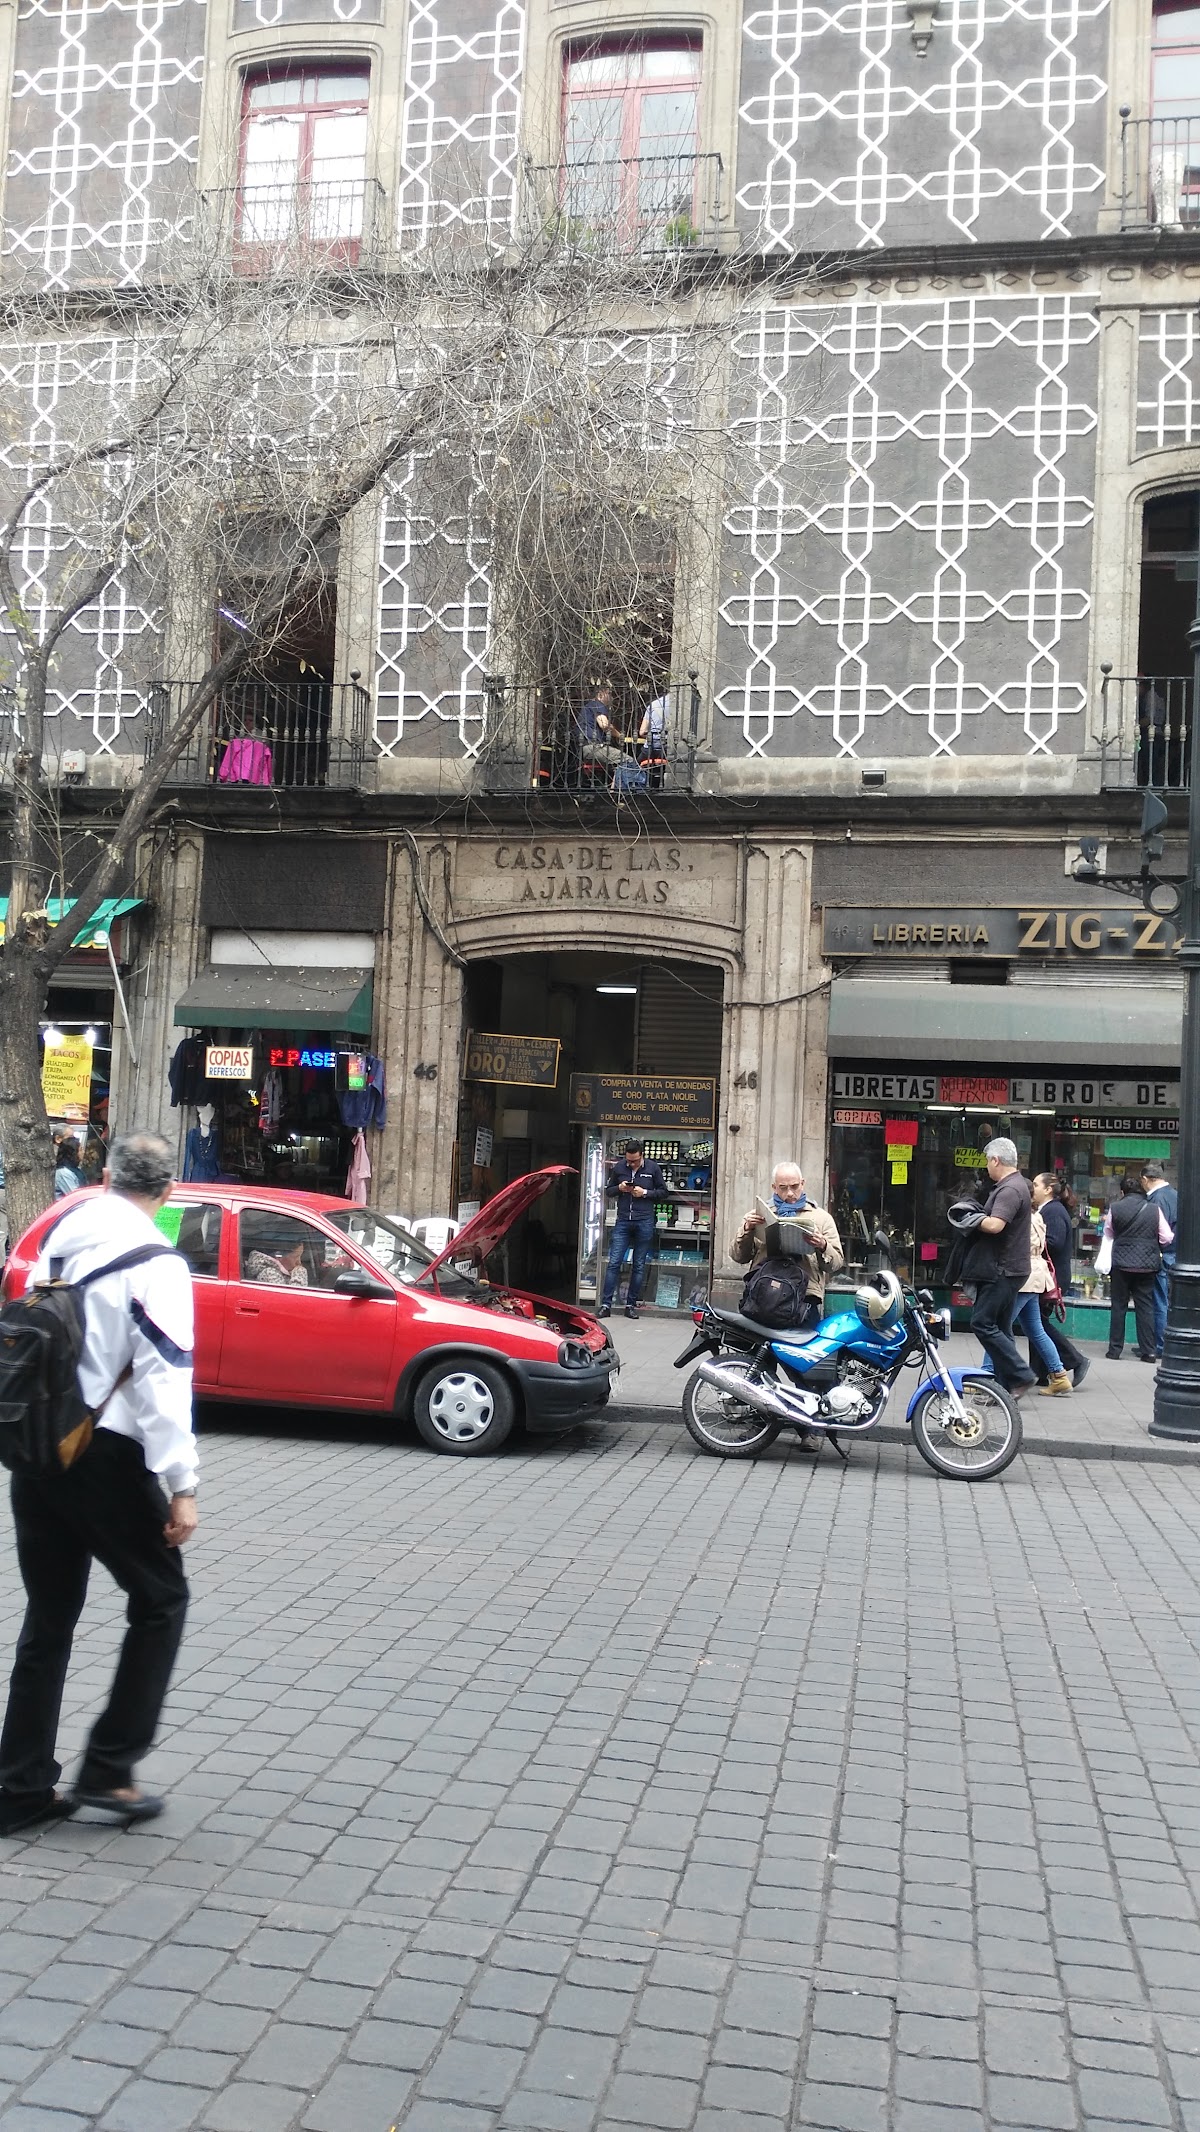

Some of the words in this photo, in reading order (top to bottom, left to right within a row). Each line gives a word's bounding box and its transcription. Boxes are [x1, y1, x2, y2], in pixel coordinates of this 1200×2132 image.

[520, 876, 670, 903] AJARACAS
[872, 923, 989, 944] LIBRERIA
[498, 1038, 525, 1048] JOYERIA
[531, 1040, 552, 1050] CESAR
[52, 1048, 80, 1059] TACOS
[209, 1050, 250, 1066] COPIAS
[511, 1055, 530, 1063] PLATA
[46, 1060, 74, 1068] SUADERO
[469, 1052, 506, 1073] ORO
[208, 1066, 246, 1077] REFRESCOS
[413, 1063, 438, 1081] 46
[601, 1078, 632, 1088] COMPRA
[632, 1080, 638, 1088] Y
[639, 1080, 663, 1089] VENTA
[665, 1081, 675, 1089] DE
[676, 1081, 711, 1091] MONEDAS
[734, 1070, 758, 1090] 46
[43, 1086, 73, 1095] CARNITAS
[831, 1075, 935, 1100] LIBRETAS
[612, 1090, 622, 1099] DE
[626, 1091, 642, 1099] ORO
[646, 1091, 669, 1100] PLATA
[672, 1092, 698, 1102] NIQUEL
[942, 1090, 953, 1102] DE
[959, 1090, 995, 1103] TEXTO
[1137, 1084, 1167, 1105] DE
[622, 1102, 646, 1111] COBRE
[650, 1103, 656, 1111] Y
[658, 1103, 689, 1113] BRONCE
[614, 1114, 632, 1122] MAYO
[680, 1116, 711, 1125] 5512-8152
[836, 1111, 880, 1123] COPIAS
[1080, 1118, 1131, 1130] SELLOS
[1135, 1120, 1152, 1130] DE
